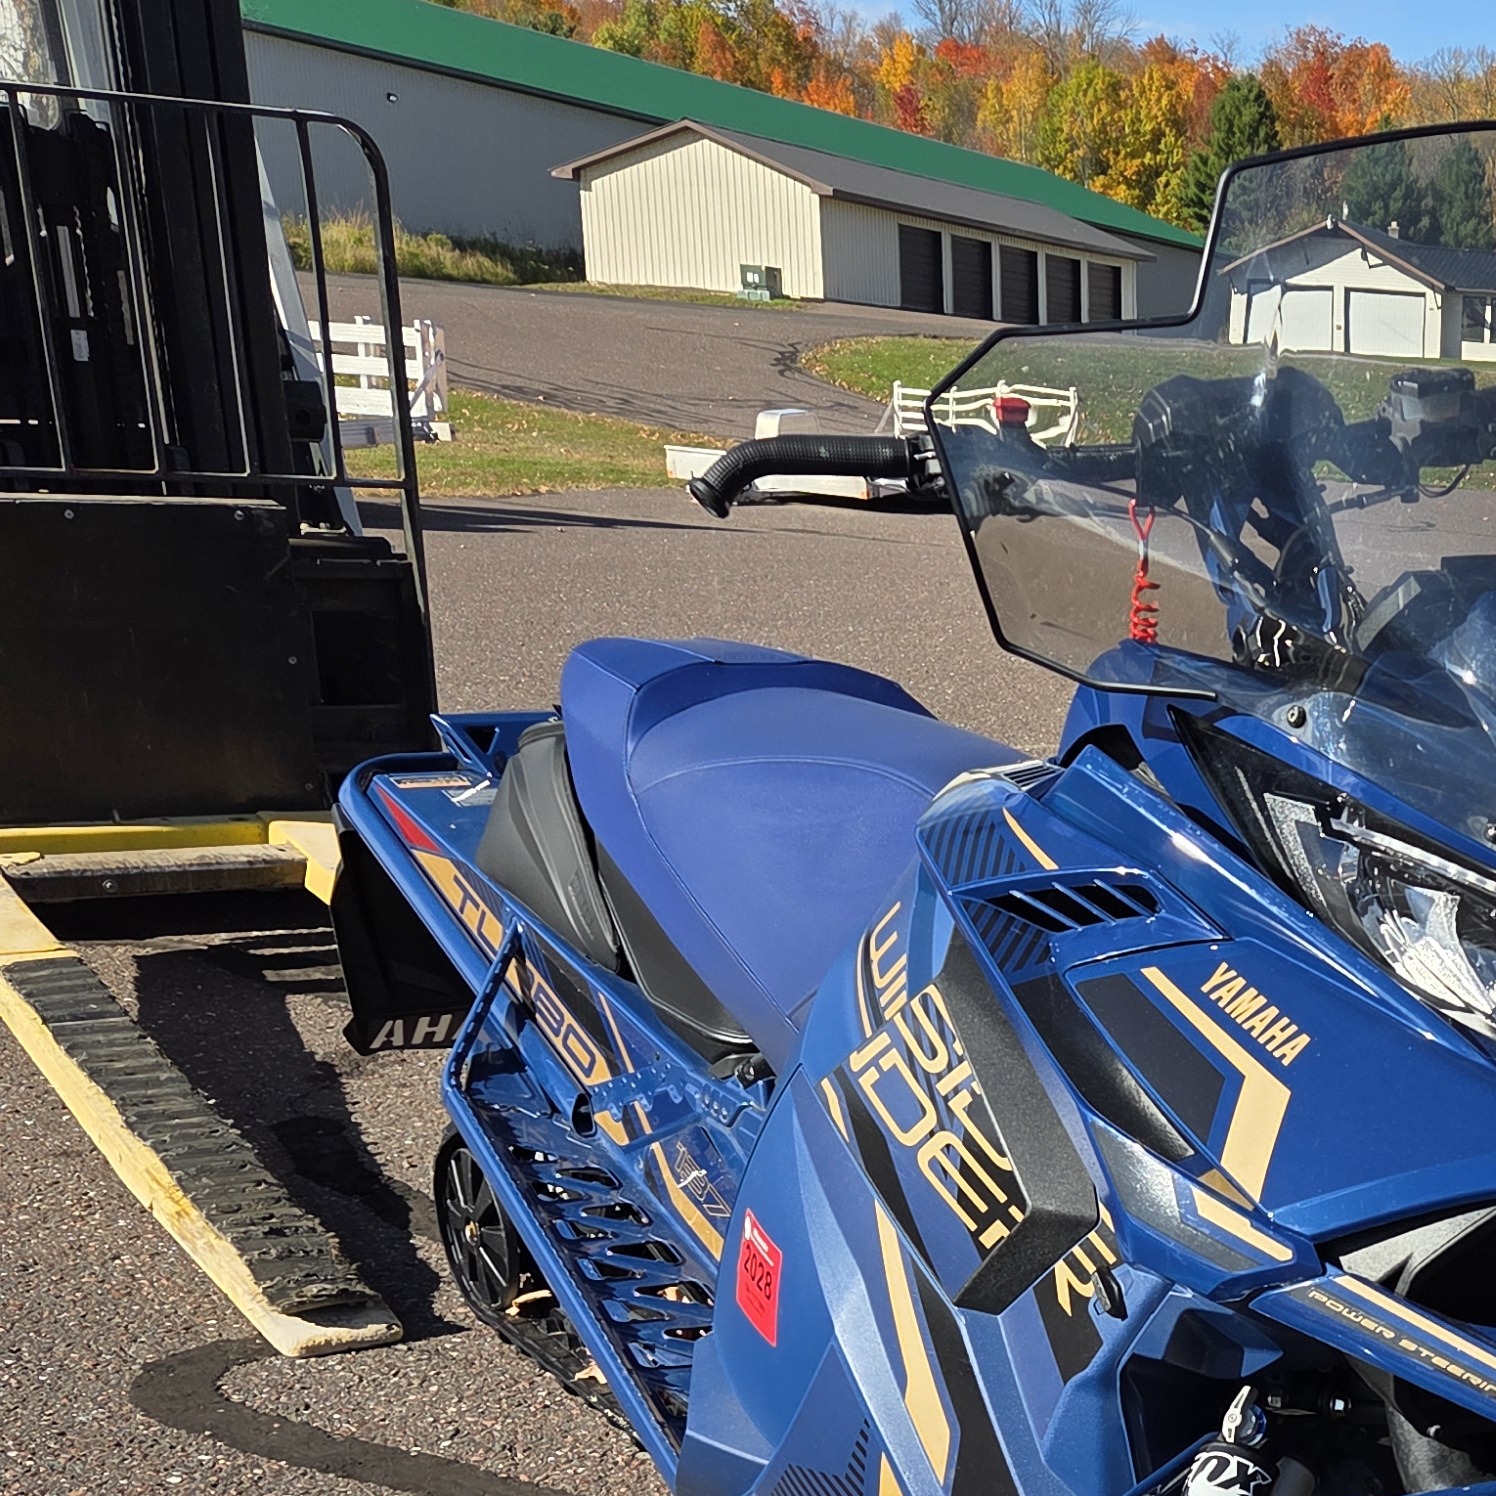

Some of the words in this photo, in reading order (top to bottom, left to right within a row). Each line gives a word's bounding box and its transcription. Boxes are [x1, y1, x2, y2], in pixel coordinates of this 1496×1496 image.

[453, 873, 597, 1080] TUBO
[1200, 962, 1311, 1067] YAMAHA
[743, 1243, 773, 1301] 2028
[1308, 1288, 1396, 1340] POWER
